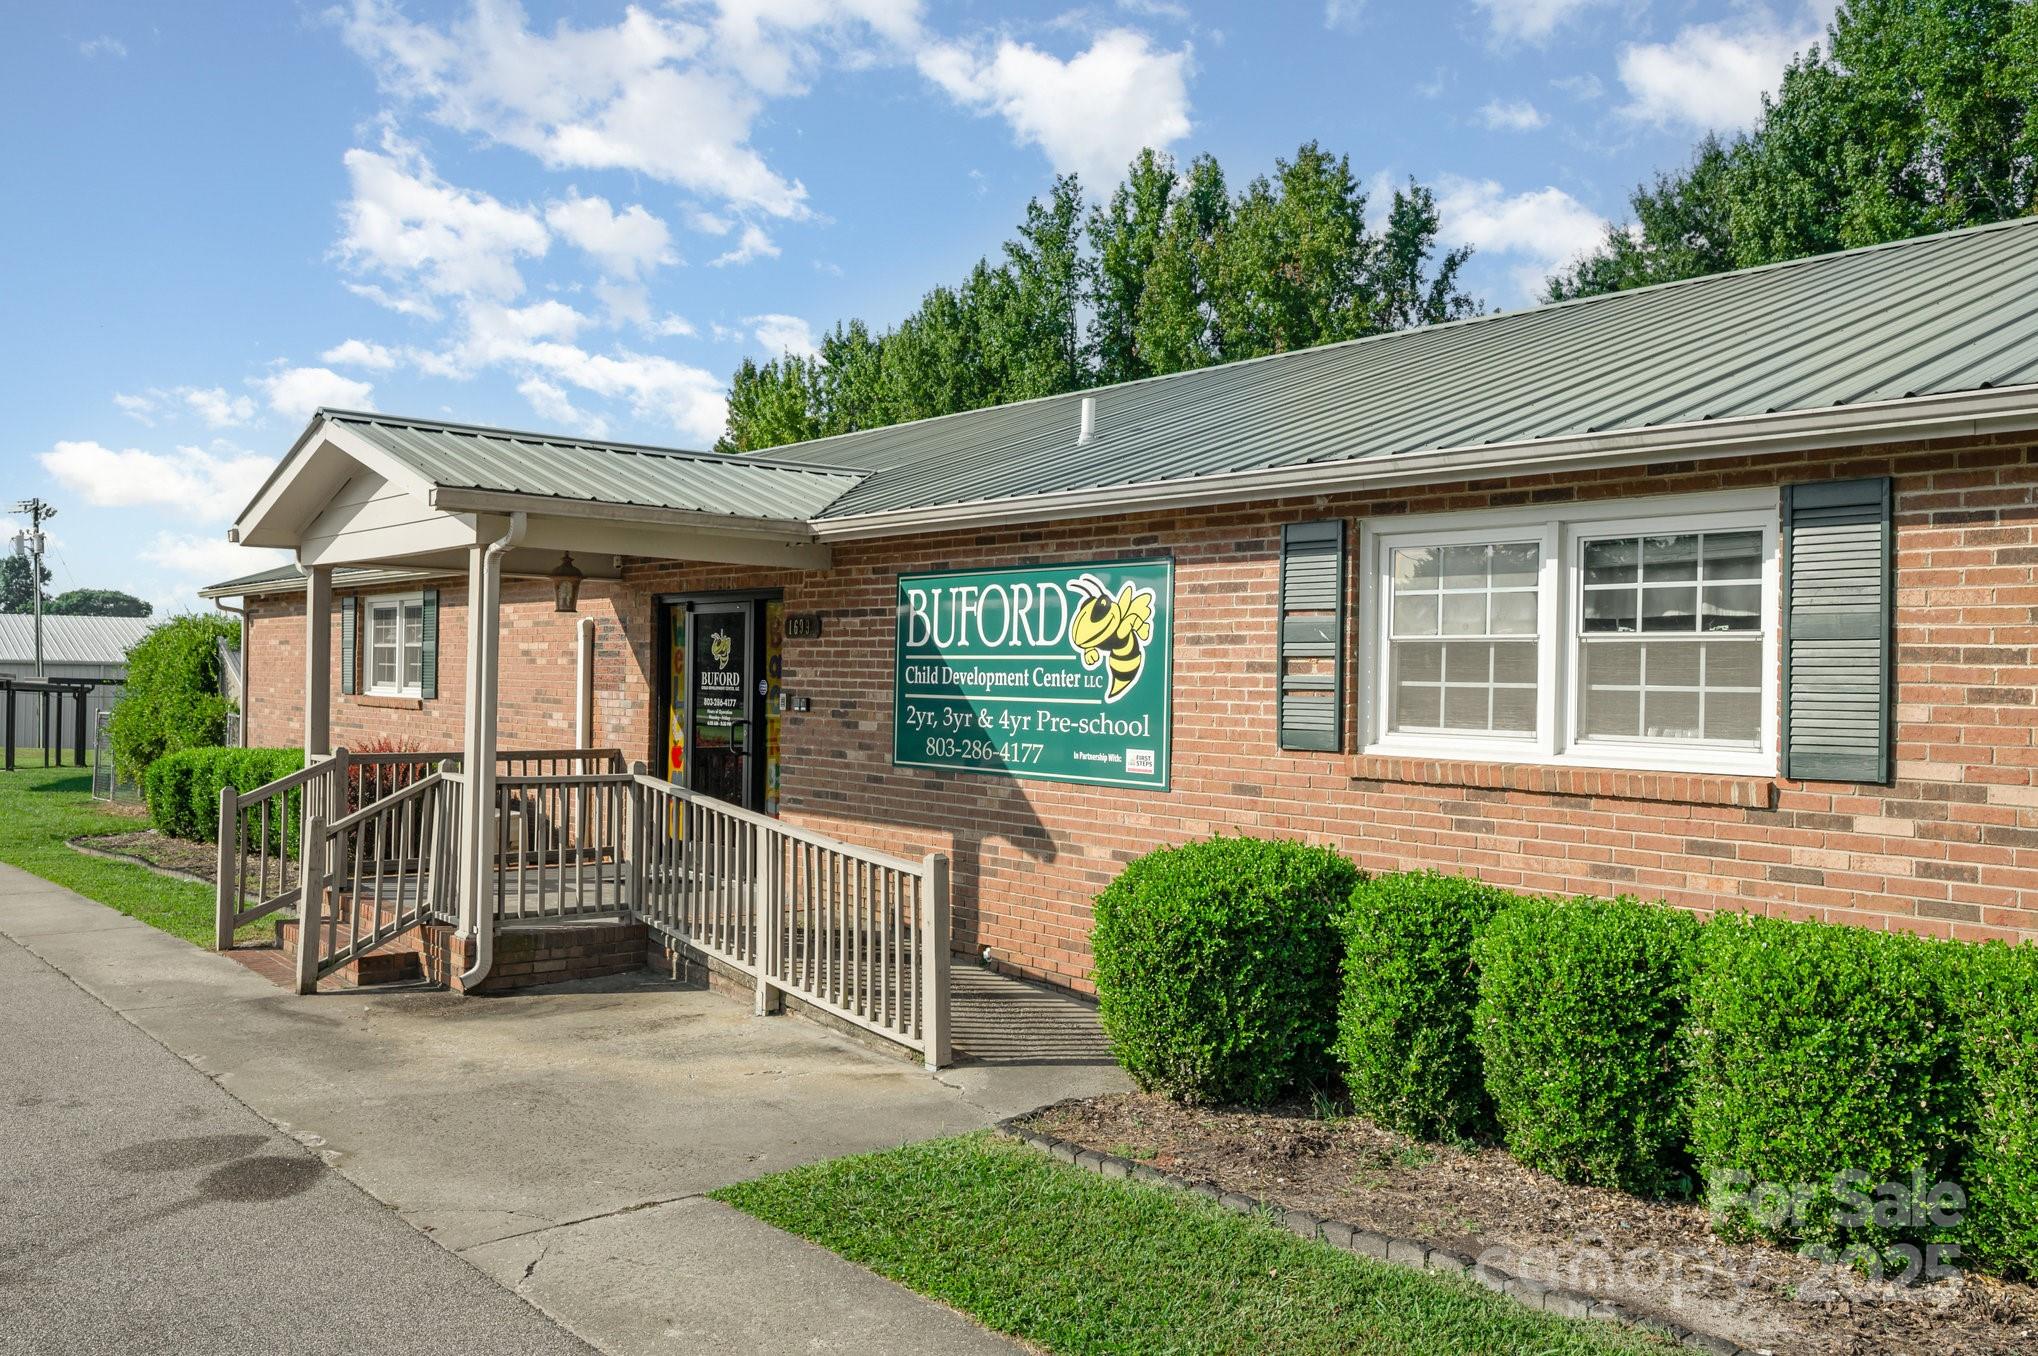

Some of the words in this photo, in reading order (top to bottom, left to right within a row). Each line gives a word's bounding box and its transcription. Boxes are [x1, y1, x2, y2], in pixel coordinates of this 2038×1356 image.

[906, 583, 1068, 648] BUFORD
[701, 671, 740, 686] BUFORD
[905, 666, 938, 685] Child
[942, 666, 1030, 692] Development
[1032, 667, 1082, 688] Center
[1084, 675, 1103, 688] LLC
[703, 697, 737, 707] 803-286-4177
[906, 705, 938, 731] 2yr,
[943, 707, 972, 733] 3yr
[978, 708, 994, 728] &
[998, 709, 1031, 737] 4yr
[1036, 710, 1151, 737] Pre-school
[926, 737, 1044, 763] 803-286-4177
[1073, 750, 1079, 760] In
[1079, 751, 1108, 763] Partnership
